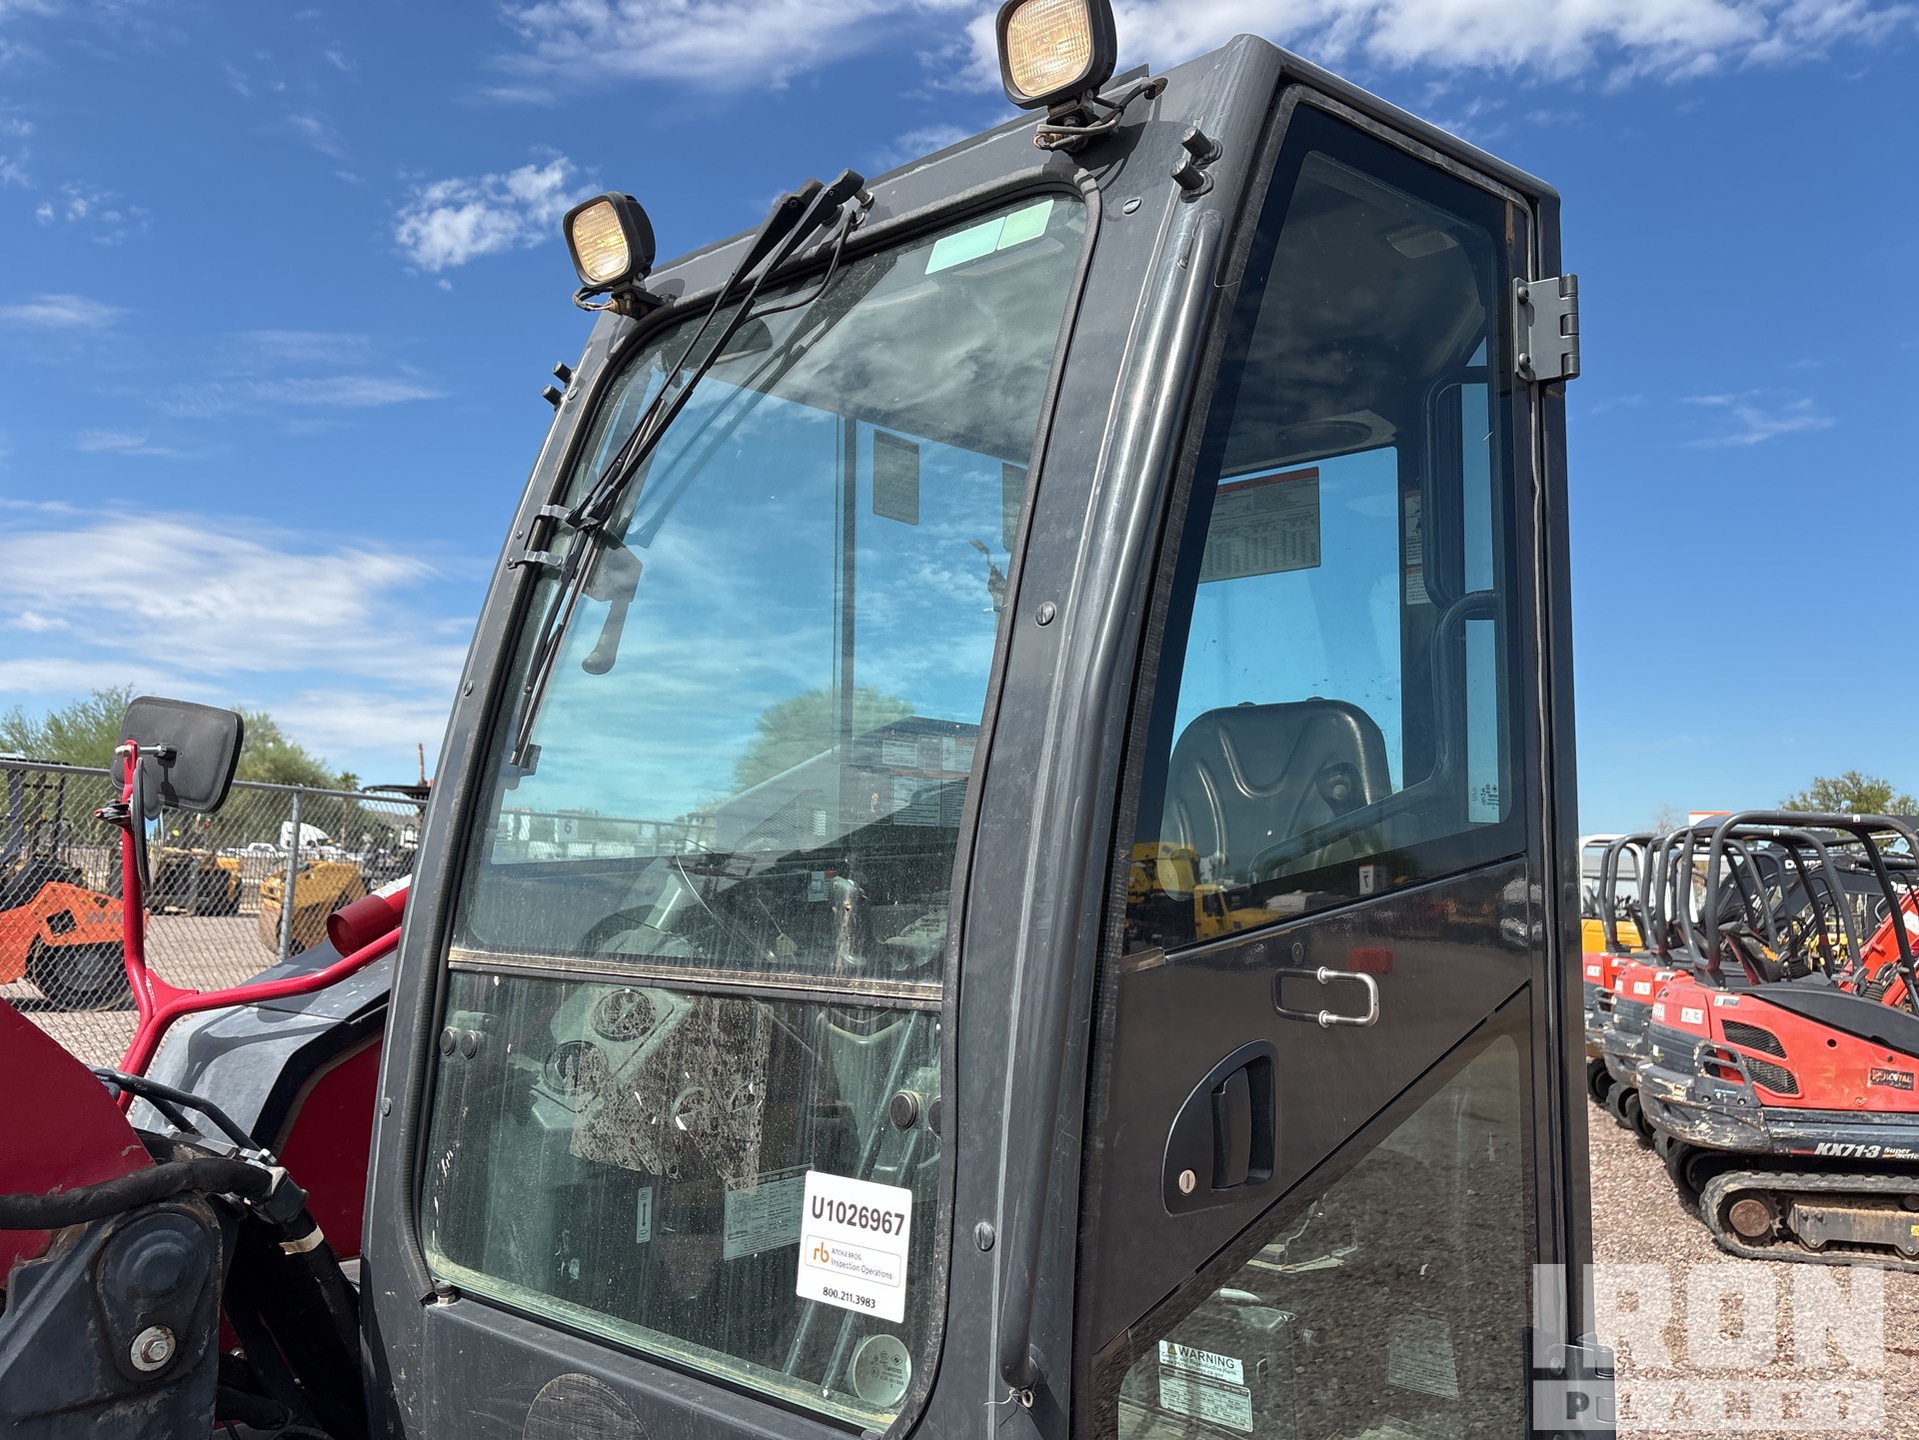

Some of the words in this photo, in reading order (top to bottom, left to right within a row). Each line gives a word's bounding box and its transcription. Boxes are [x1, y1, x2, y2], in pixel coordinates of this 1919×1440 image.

[1814, 1142, 1881, 1158] KX71-3
[1884, 1147, 1911, 1155] Super
[811, 1195, 905, 1236] U1026967
[813, 1241, 830, 1263] rb
[831, 1257, 860, 1272] Inspection
[860, 1264, 893, 1280] Operations
[823, 1286, 876, 1309] 800.211.3983
[1178, 1345, 1235, 1369] WARNING
